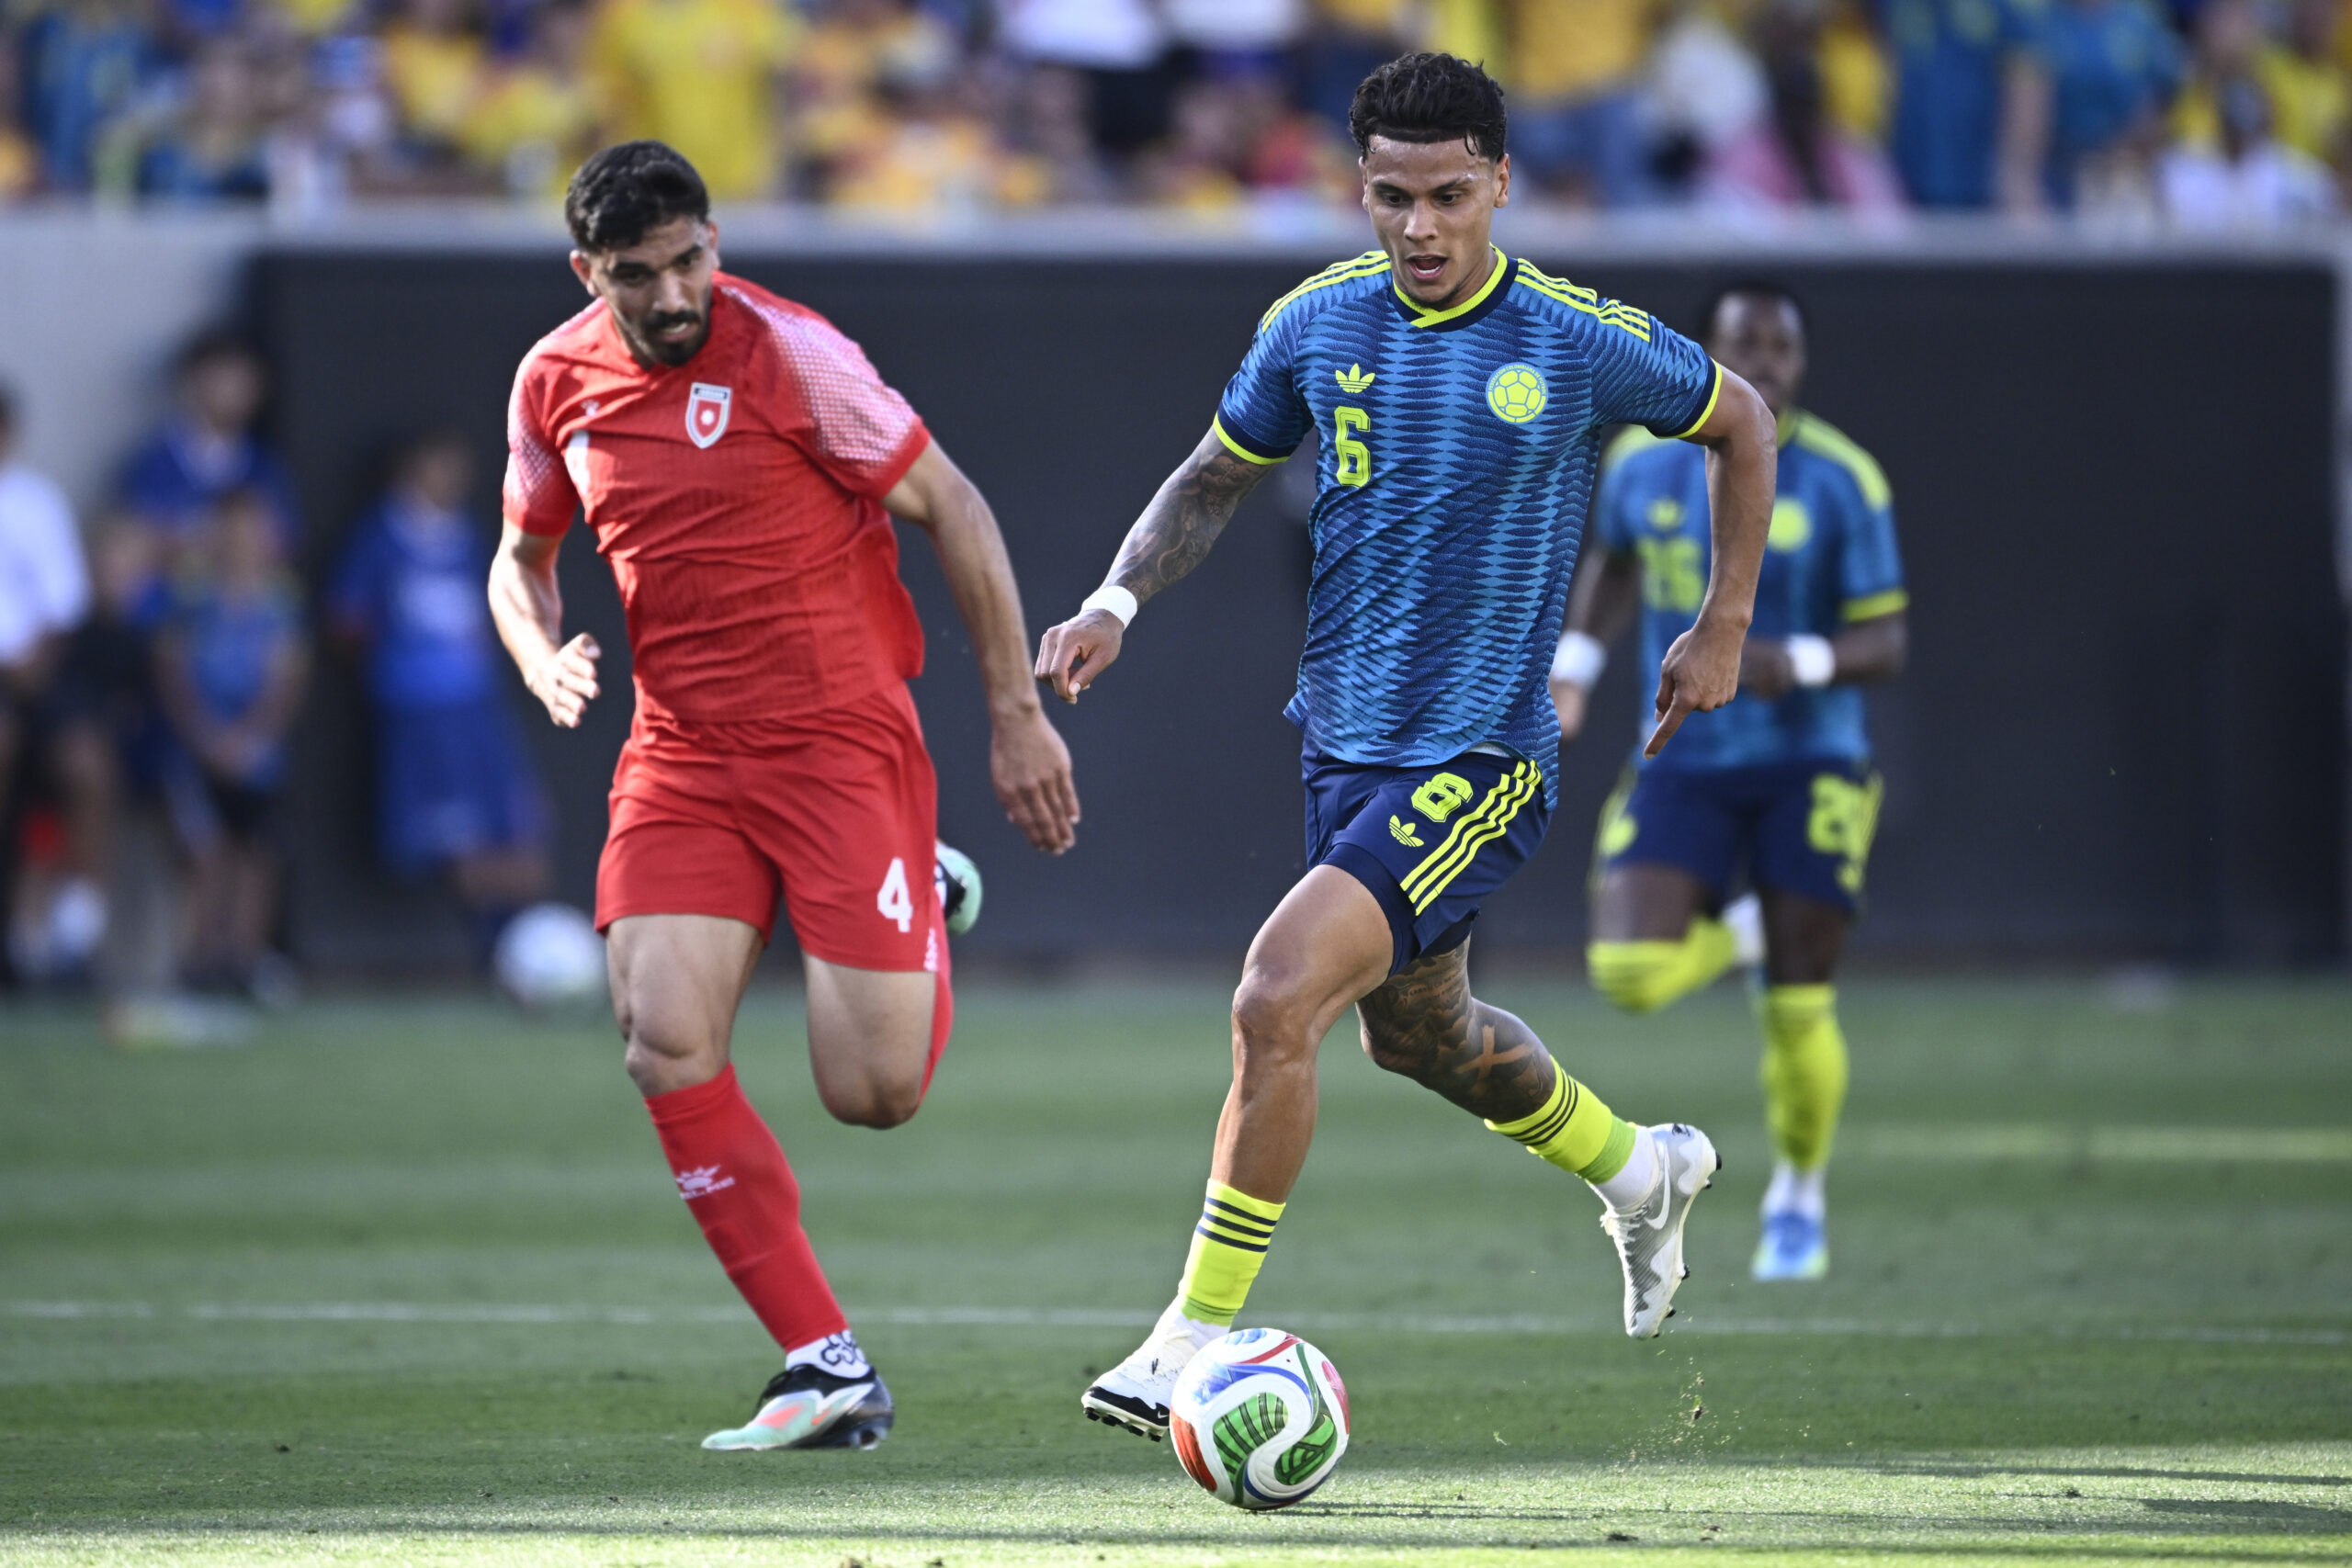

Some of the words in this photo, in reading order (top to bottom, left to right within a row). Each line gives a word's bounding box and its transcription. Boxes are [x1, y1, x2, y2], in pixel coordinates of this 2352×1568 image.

[1334, 406, 1371, 488] 6
[1411, 773, 1473, 822] 6
[877, 856, 913, 933] 4
